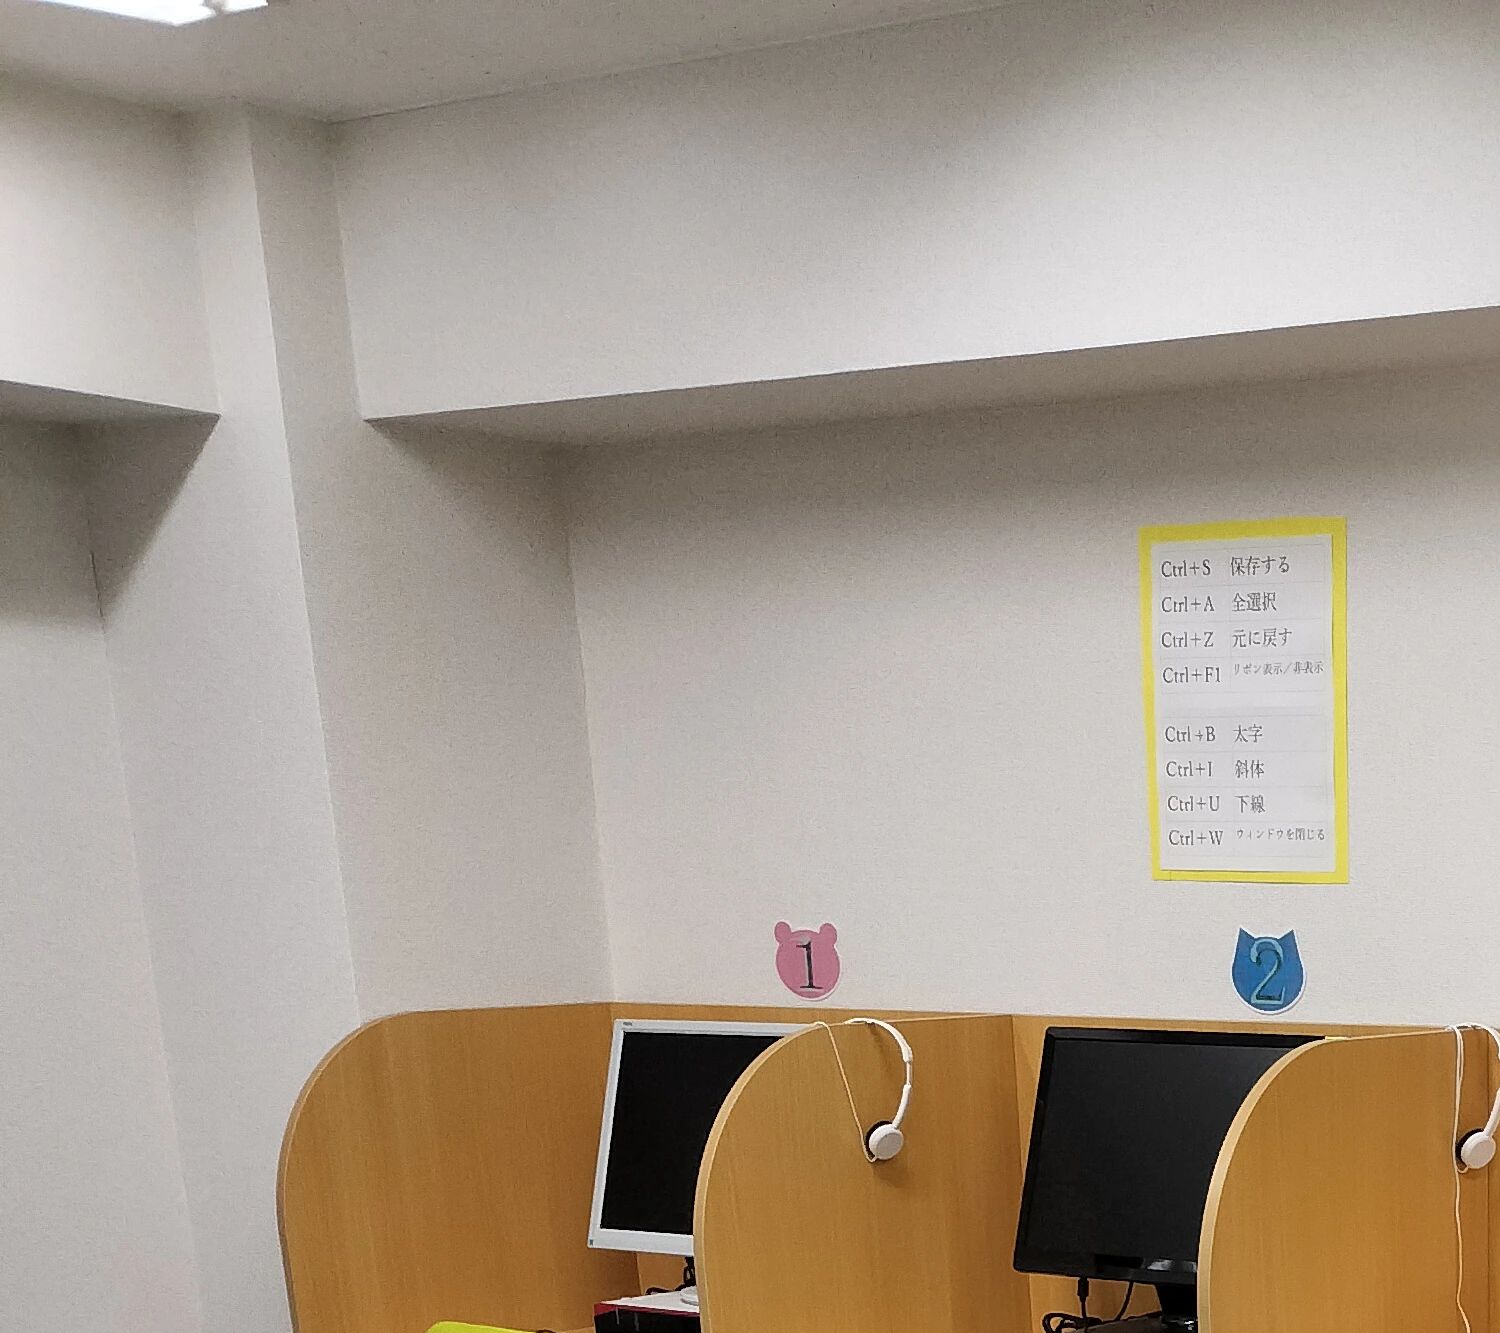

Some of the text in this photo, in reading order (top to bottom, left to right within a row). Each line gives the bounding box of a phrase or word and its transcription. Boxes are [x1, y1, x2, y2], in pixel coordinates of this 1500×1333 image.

[1161, 556, 1290, 578] Ctrl+S 保存する
[1161, 592, 1277, 613] Ctrl+A 全選択
[1161, 628, 1293, 648] Ctrl+Z 元に戻す
[1162, 667, 1221, 684] Ctrl+F1
[1165, 724, 1263, 743] Ctrl+B 太字
[1166, 759, 1265, 778] Ctrl+I 斜体
[1168, 795, 1266, 813] Ctrl+U 下線
[1168, 830, 1223, 846] Ctrl+W
[795, 939, 824, 991] 1
[1250, 939, 1286, 1004] 2
